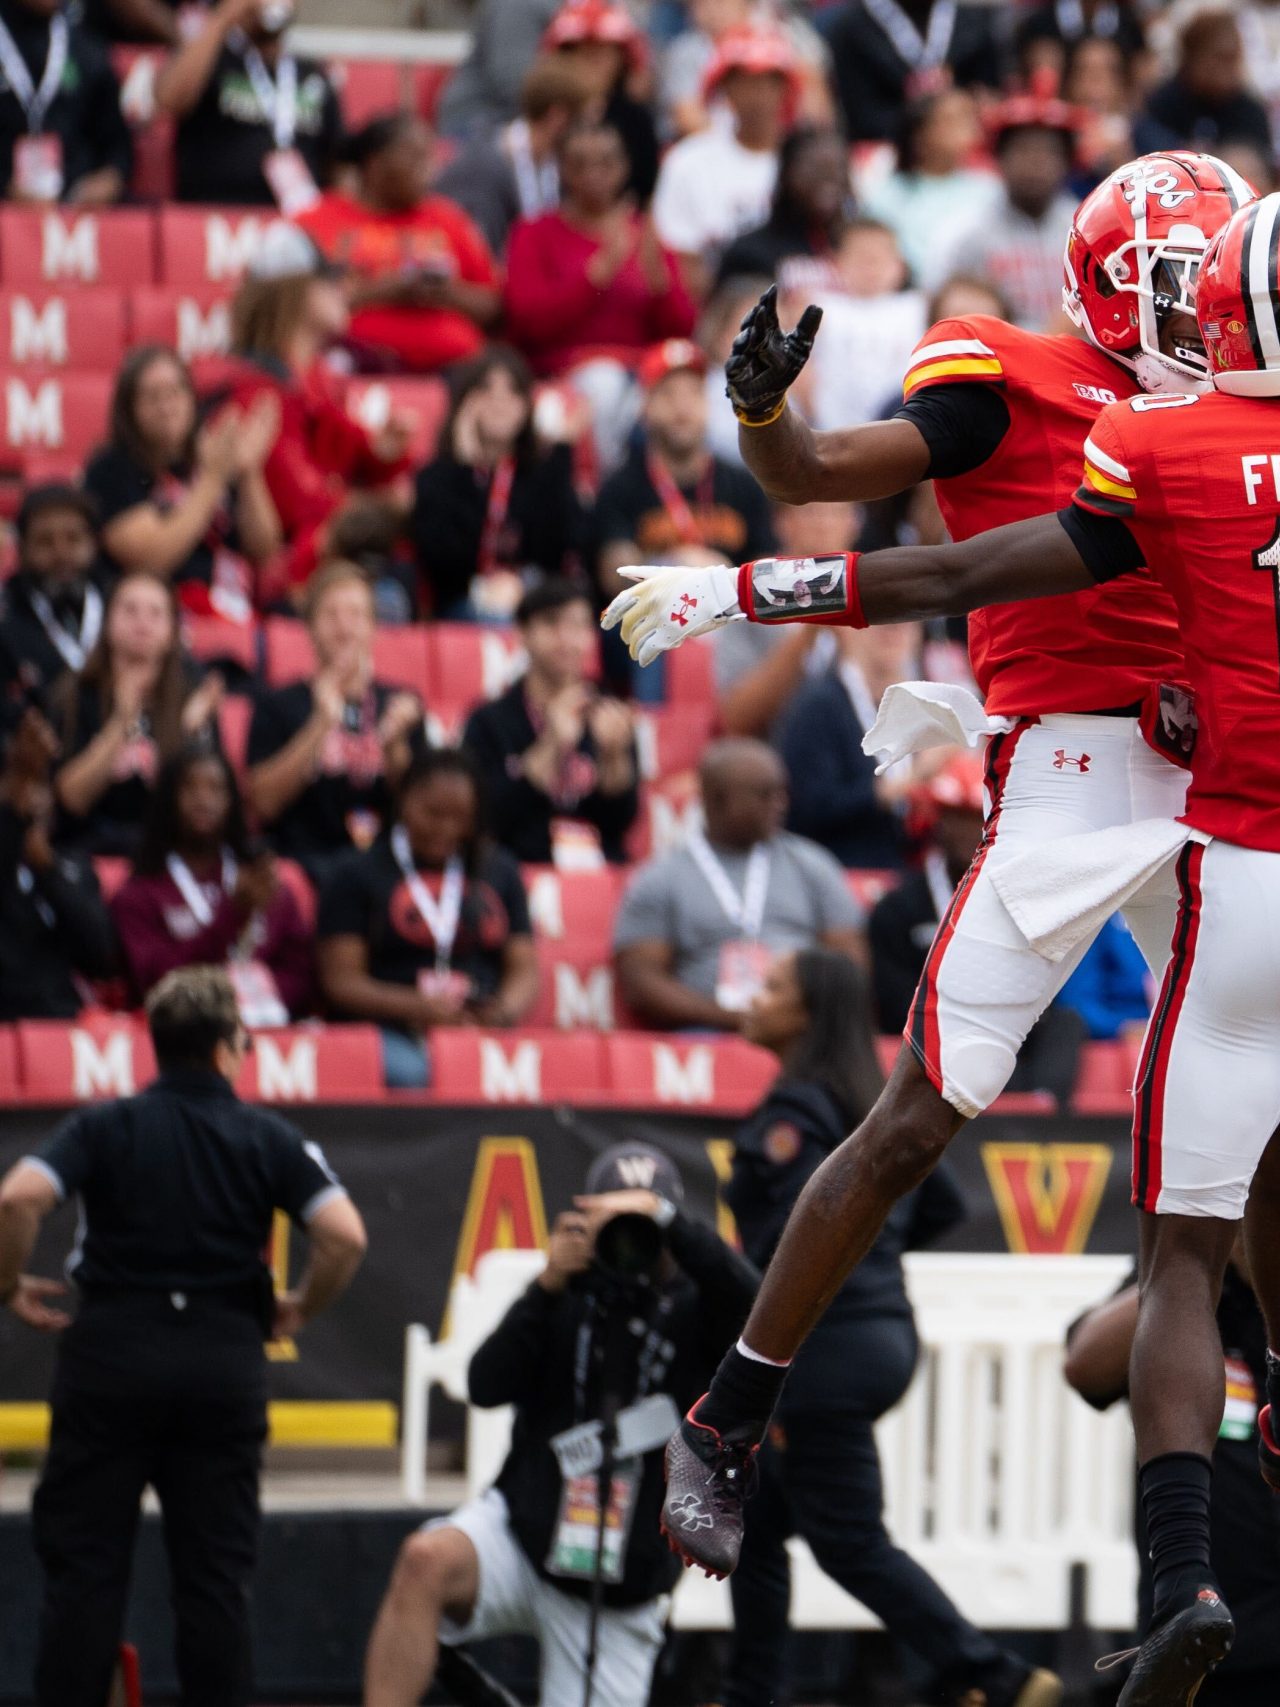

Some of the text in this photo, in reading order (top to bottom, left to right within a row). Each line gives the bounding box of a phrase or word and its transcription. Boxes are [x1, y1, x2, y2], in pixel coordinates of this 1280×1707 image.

[43, 213, 98, 282] M
[10, 297, 67, 364] M
[6, 377, 64, 447] M
[71, 1028, 135, 1099] M
[256, 1036, 318, 1101] M
[480, 1038, 543, 1102] M
[652, 1043, 716, 1103] M
[616, 1157, 656, 1190] W
